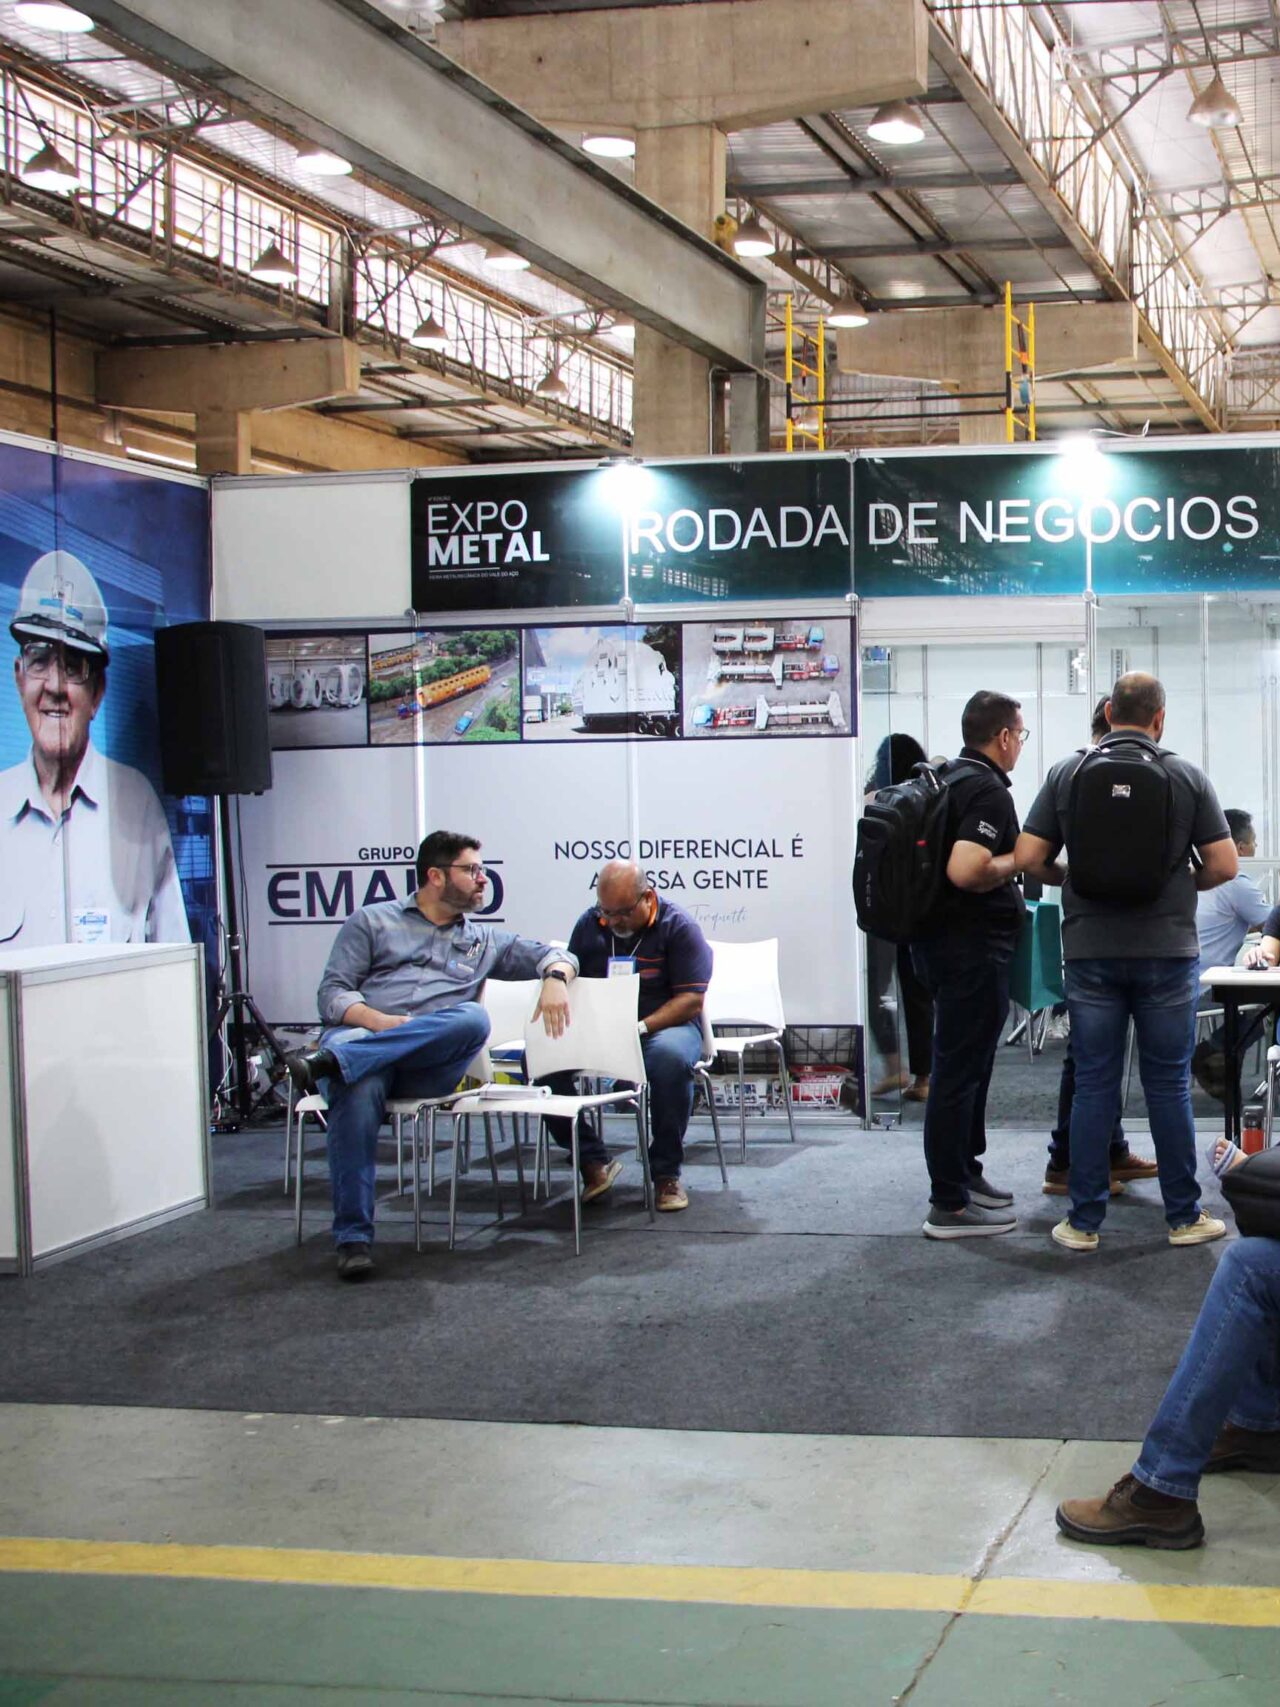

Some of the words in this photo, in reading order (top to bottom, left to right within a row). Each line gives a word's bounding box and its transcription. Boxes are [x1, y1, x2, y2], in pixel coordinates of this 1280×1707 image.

[428, 499, 528, 534] EXPO
[630, 504, 850, 555] RODADA
[868, 501, 939, 546] DE
[959, 495, 1260, 544] NEGOCIOS
[427, 530, 550, 566] METAL
[358, 847, 415, 861] GRUPO
[639, 838, 784, 860] DIFERENCIAL
[791, 833, 805, 858] É
[692, 869, 769, 890] GENTE
